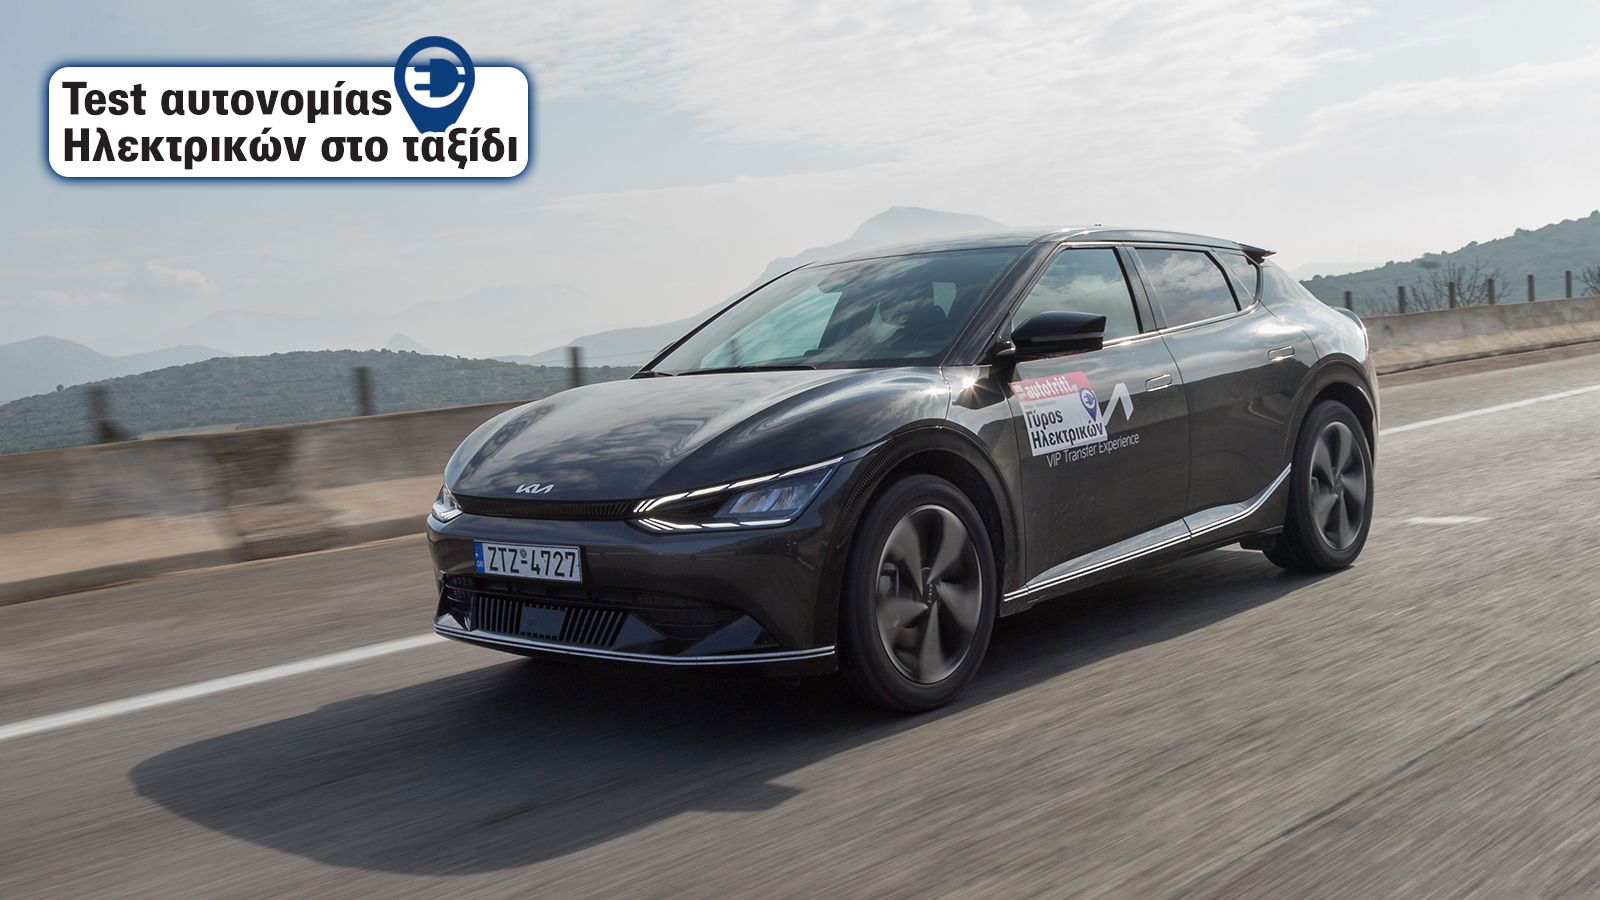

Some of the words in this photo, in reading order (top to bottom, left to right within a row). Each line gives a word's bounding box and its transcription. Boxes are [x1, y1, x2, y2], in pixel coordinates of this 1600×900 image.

[1025, 409, 1063, 430] Γύρος
[1030, 420, 1104, 449] Ηλεκτρικών
[1046, 451, 1062, 468] VIP
[1063, 443, 1097, 464] Transfer
[1098, 433, 1140, 454] Experience
[487, 546, 576, 578] ZTZ-4727
